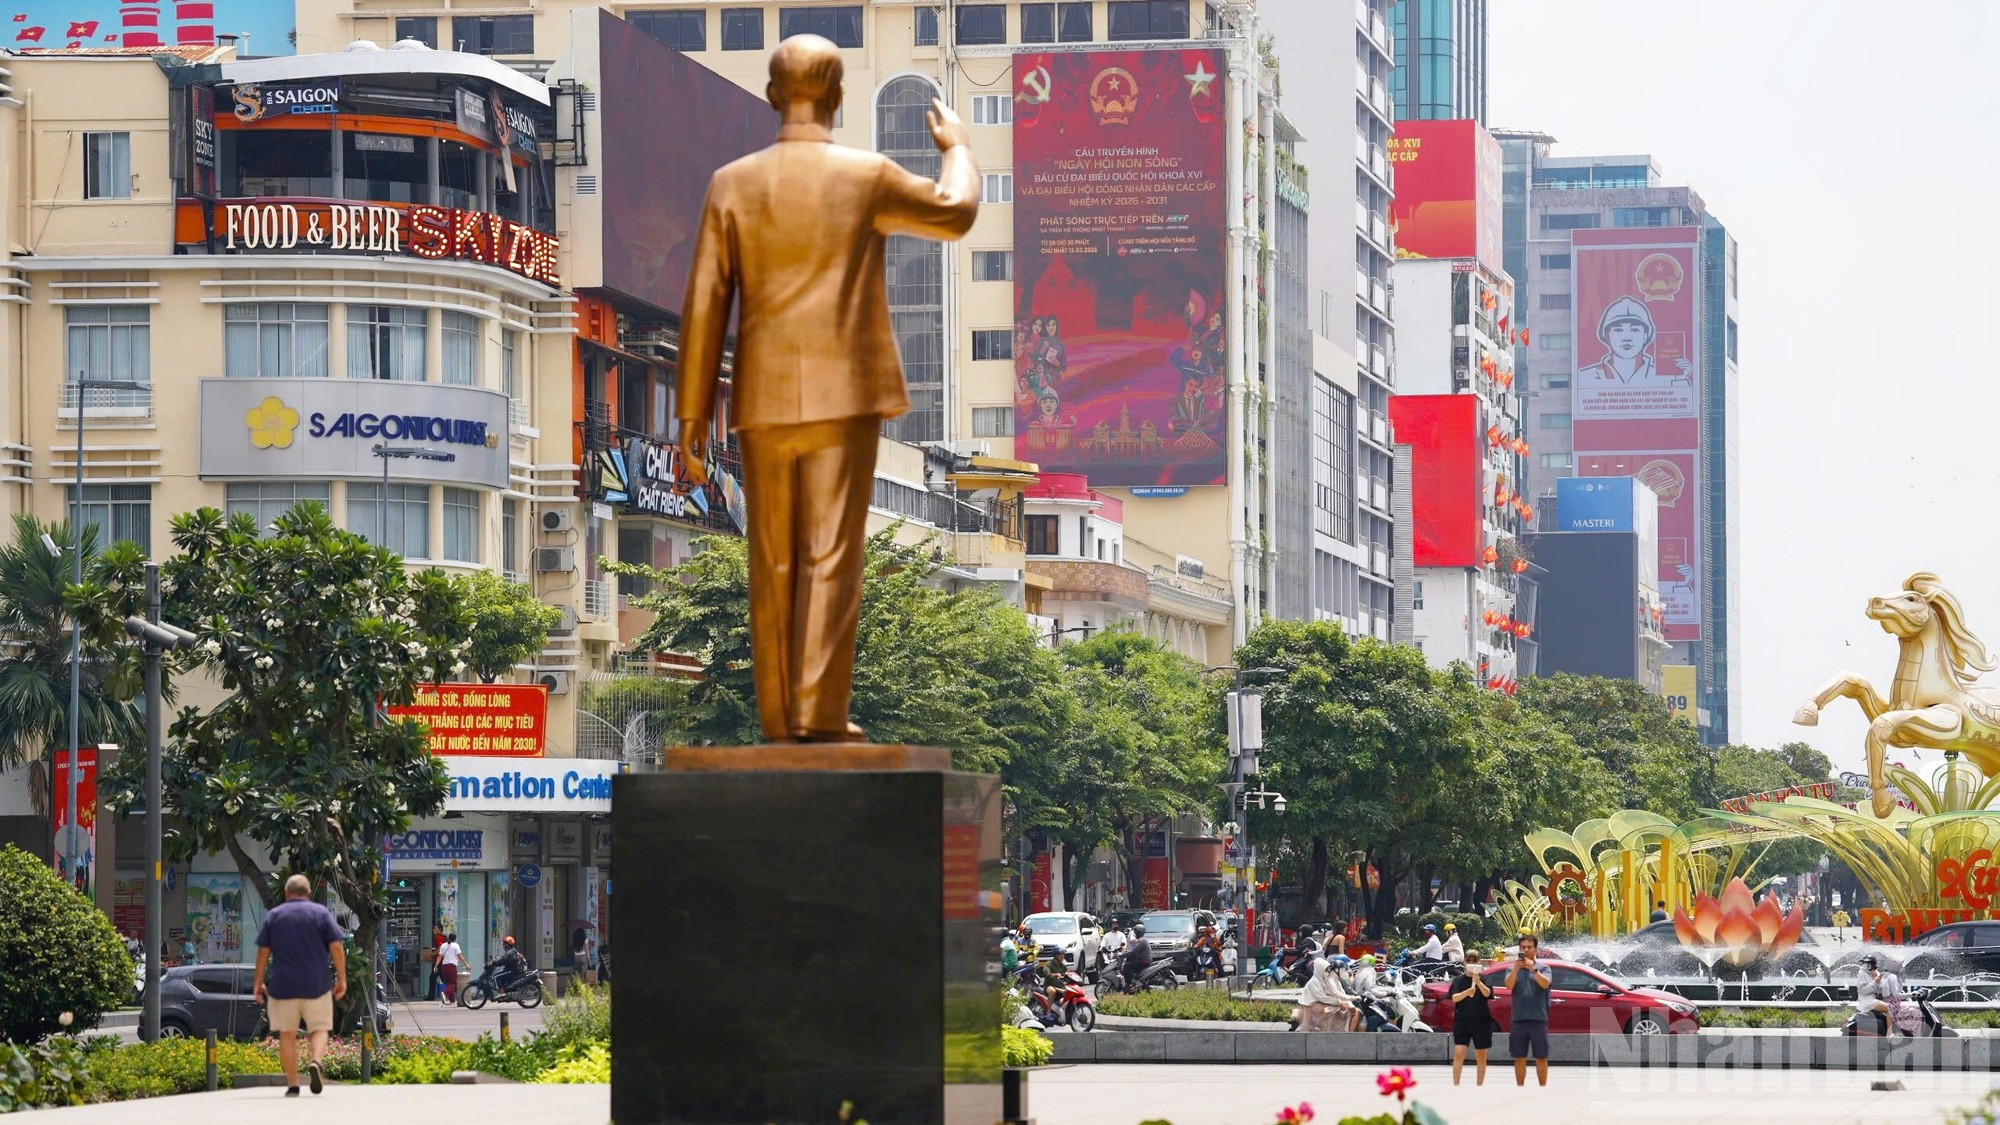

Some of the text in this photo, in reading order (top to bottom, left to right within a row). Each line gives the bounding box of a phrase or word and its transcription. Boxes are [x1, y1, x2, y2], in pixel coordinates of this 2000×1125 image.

[275, 87, 338, 104] SAIGON
[195, 118, 213, 141] SKY
[508, 107, 536, 139] SAIGON
[195, 139, 214, 158] ZONE
[1403, 138, 1421, 148] XVI
[1094, 157, 1114, 171] HỘI
[1117, 158, 1142, 168] NON
[1145, 155, 1182, 168] SÔNG"
[1400, 148, 1418, 161] CẤP
[1071, 173, 1087, 183] ĐẠI
[1112, 170, 1139, 181] QUỐC
[1141, 171, 1157, 182] HỘI
[1187, 170, 1203, 179] XVI
[1020, 184, 1035, 195] VÀ
[1036, 186, 1052, 197] ĐẠI
[1078, 185, 1094, 195] HỘI
[1125, 182, 1152, 193] NHÂN
[1154, 182, 1175, 192] DÂN
[1176, 181, 1195, 191] CÁC
[1196, 180, 1216, 191] CẤP
[1069, 197, 1099, 207] NHIỆM
[1115, 197, 1139, 206] 2026
[1145, 196, 1168, 205] 2031
[226, 204, 401, 252] FOOD & BEER
[1040, 215, 1064, 226] PHÁT
[1065, 215, 1091, 225] SÓNG
[1093, 215, 1117, 226] TRỰC
[1118, 213, 1139, 224] TIẾP
[1139, 213, 1164, 223] TRÊN
[408, 204, 561, 288] SKY ZONE
[308, 411, 488, 447] SAIGONTOURIST
[646, 446, 676, 483] CHILL
[638, 481, 661, 511] CHẤT
[660, 487, 685, 517] RIÊNG
[1572, 518, 1615, 529] MASTERI
[442, 690, 462, 708] SỨC,
[463, 690, 487, 707] ĐỒNG
[488, 691, 511, 707] LÒNG
[1666, 695, 1688, 711] 89
[431, 711, 459, 730] THẮNG
[460, 713, 475, 731] LỢI
[475, 713, 492, 729] CÁC
[494, 714, 514, 731] MỤC
[515, 714, 534, 729] TIÊU
[430, 733, 447, 750] ĐẤT
[448, 734, 471, 750] NƯỚC
[472, 733, 490, 750] ĐẾN
[492, 734, 512, 751] NĂM
[513, 737, 537, 751] 2030!
[450, 772, 555, 799] mation
[441, 850, 481, 858] SERVICE
